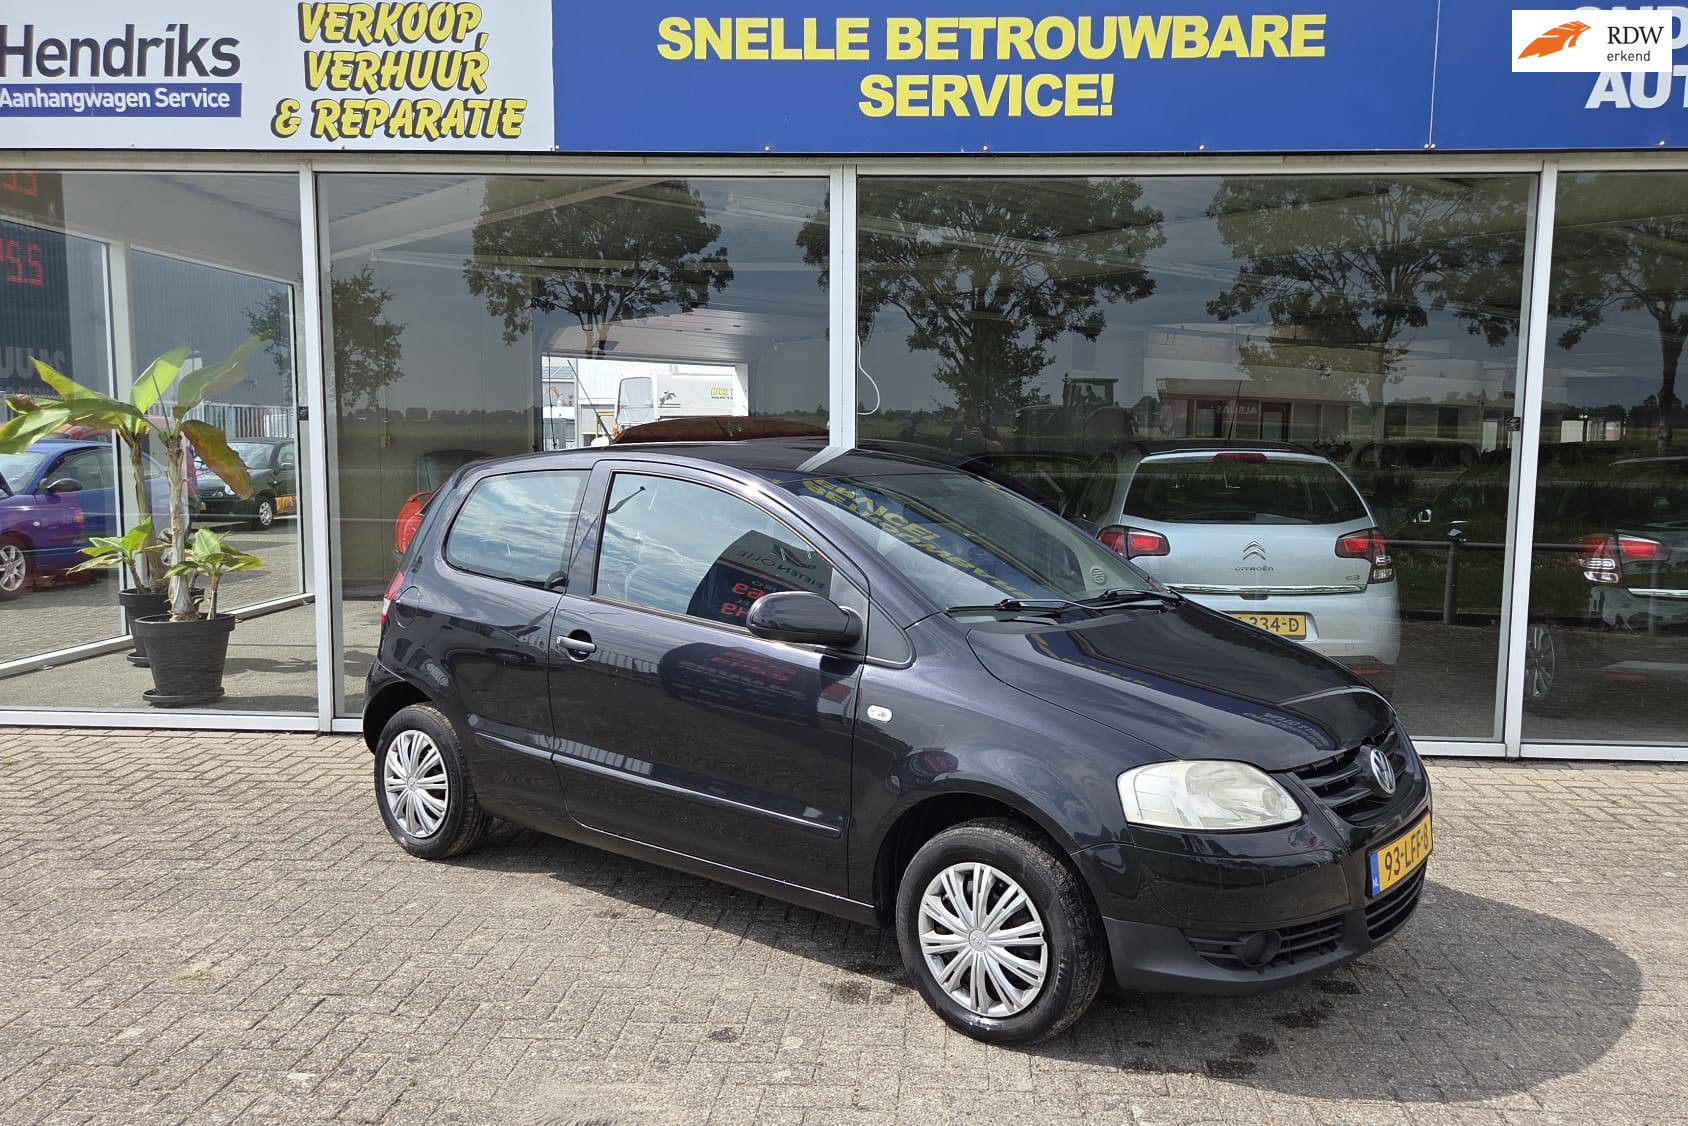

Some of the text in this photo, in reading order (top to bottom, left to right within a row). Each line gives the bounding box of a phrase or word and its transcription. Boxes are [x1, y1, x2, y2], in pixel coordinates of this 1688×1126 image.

[298, 2, 489, 51] VERKOOP,
[657, 14, 1326, 61] SNELLE BETROUWBARE
[304, 50, 489, 95] VERHUUR
[0, 87, 230, 112] Aanhangwagen Service
[858, 73, 1114, 118] SERVICE!
[270, 98, 528, 142] & REPARATIE
[1384, 823, 1429, 881] 93-LFF-8
